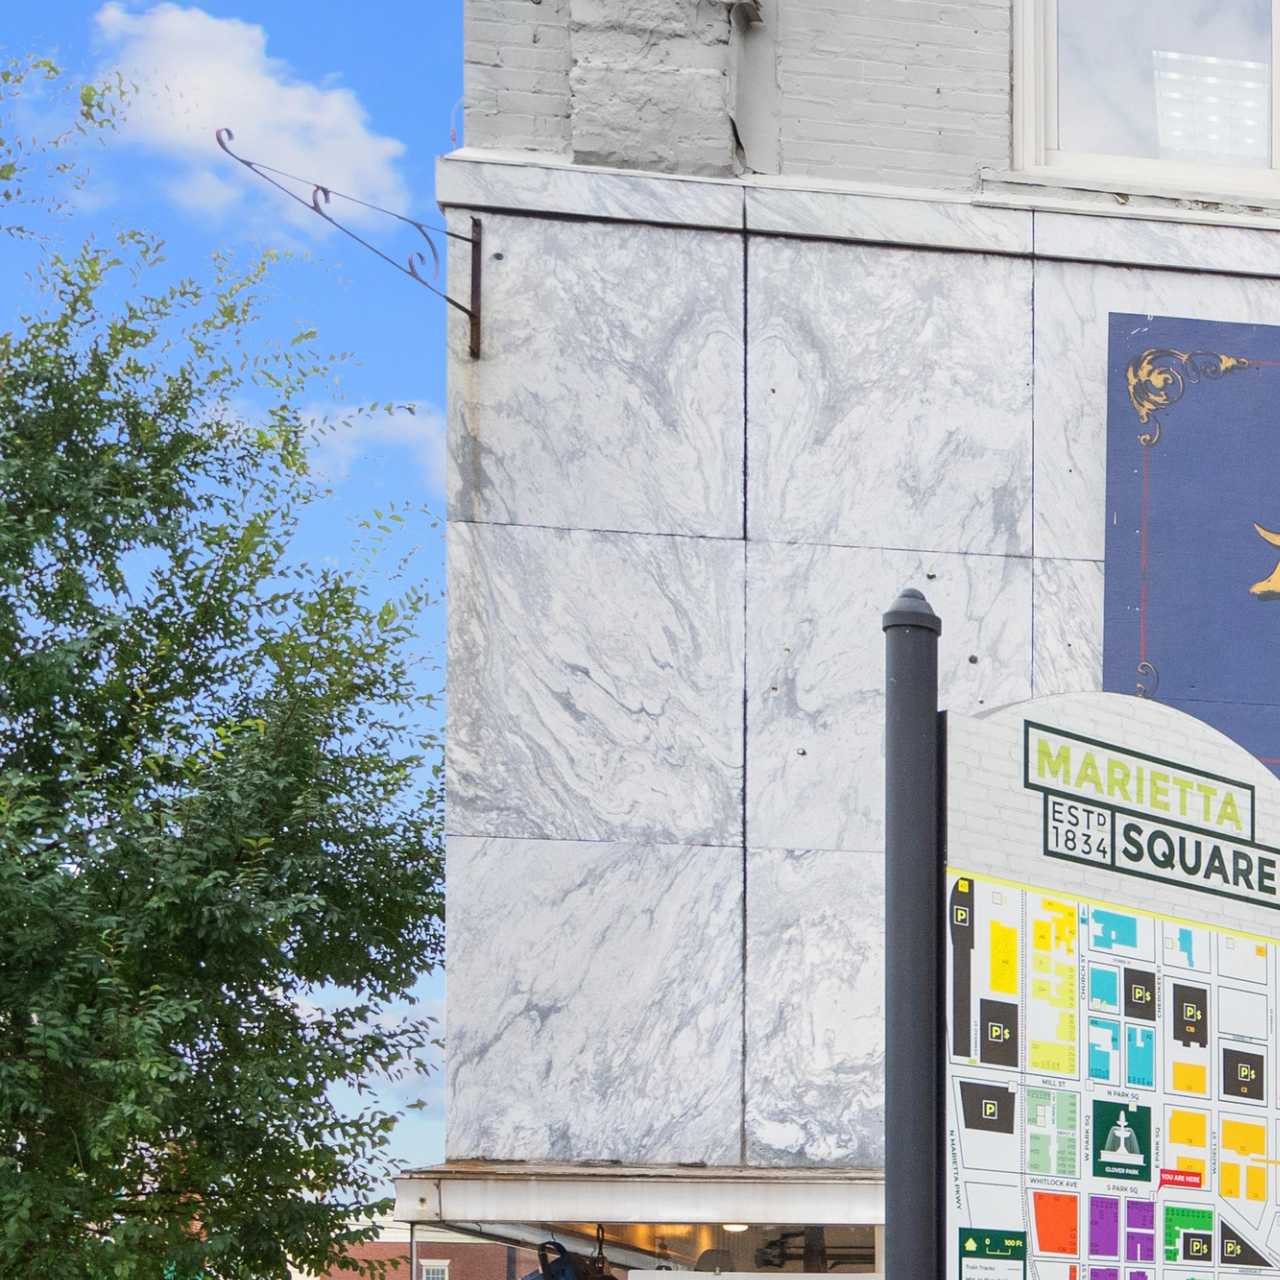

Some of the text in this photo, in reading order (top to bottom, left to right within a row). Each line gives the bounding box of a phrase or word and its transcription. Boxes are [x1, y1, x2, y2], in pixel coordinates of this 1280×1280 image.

[1036, 737, 1242, 831] MARIETTA
[1052, 826, 1108, 859] 1834
[1122, 822, 1277, 896] SQUARE
